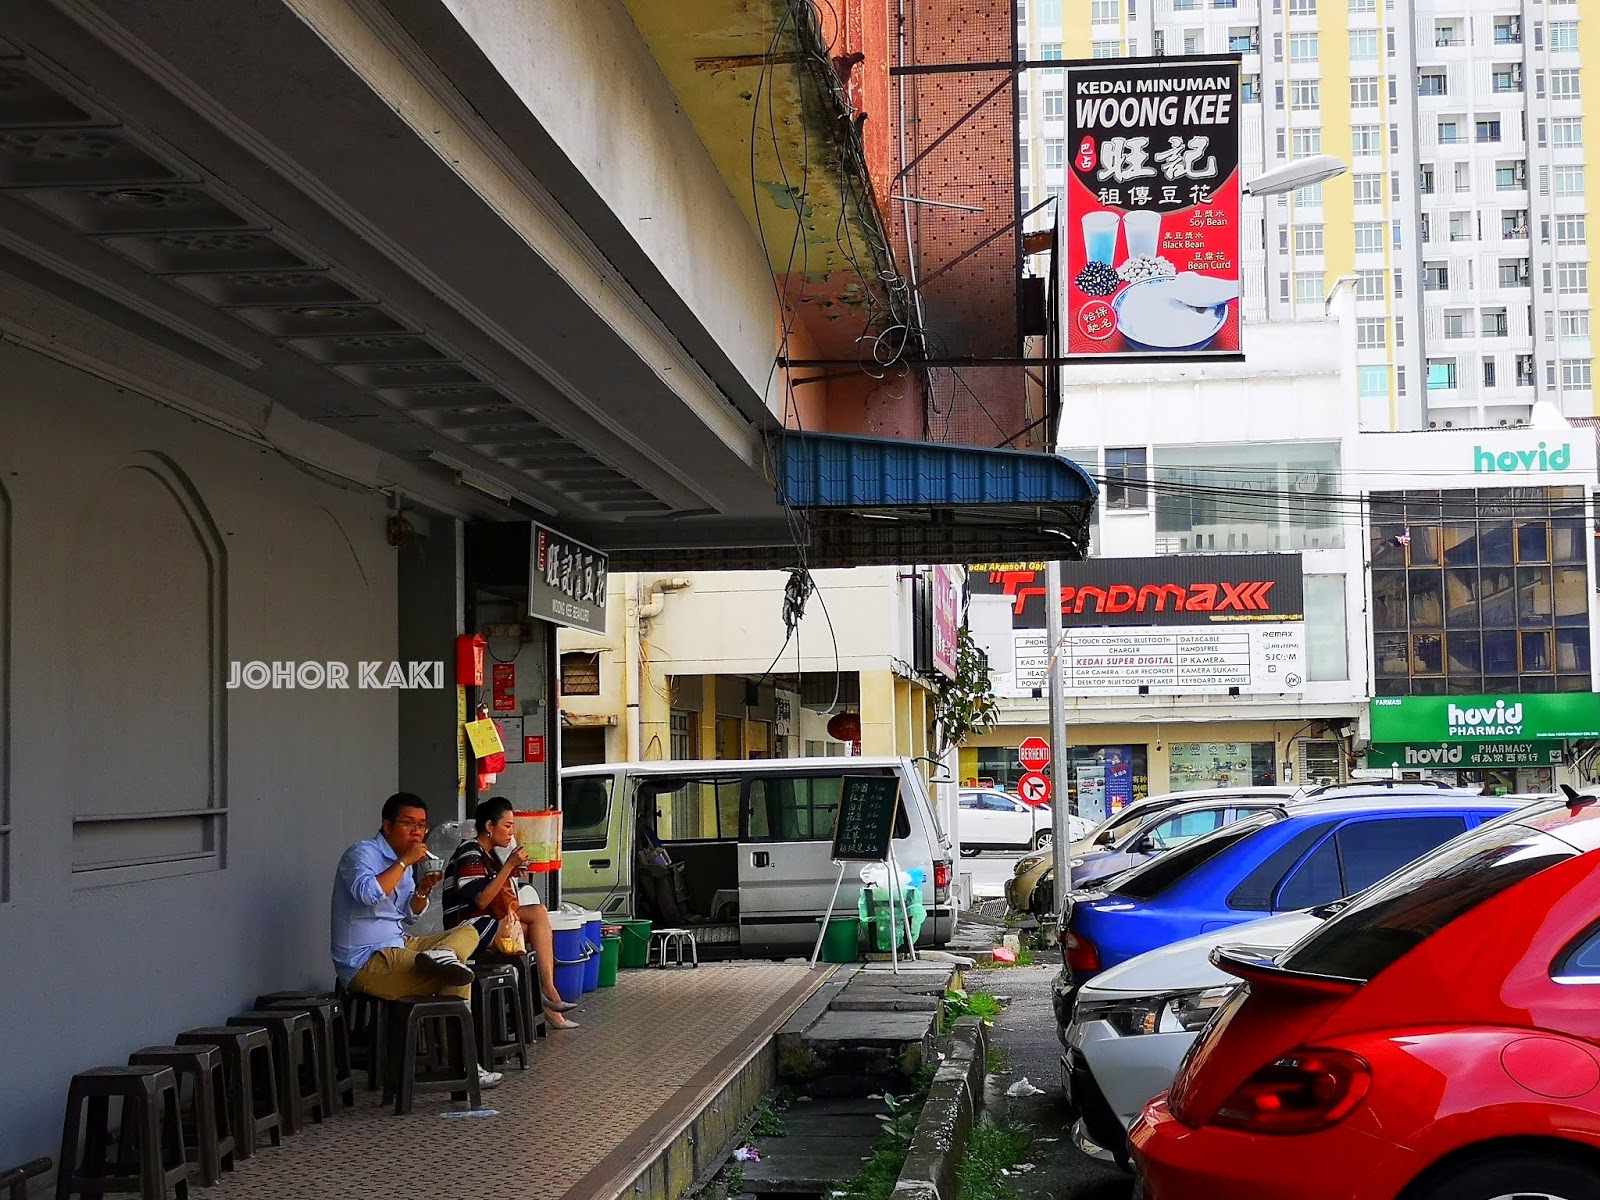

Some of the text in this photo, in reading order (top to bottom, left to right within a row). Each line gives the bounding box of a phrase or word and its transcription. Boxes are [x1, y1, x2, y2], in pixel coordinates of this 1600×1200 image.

[1077, 77, 1230, 94] KEDAI MINUMAN
[1076, 94, 1232, 128] WOONG KEE
[1097, 136, 1218, 183] 旺記
[1098, 184, 1213, 205] 祖傳豆花
[1189, 218, 1227, 228] Soy Bean
[1162, 241, 1183, 249] Black
[1188, 260, 1231, 270] Bean Curd
[1474, 441, 1571, 473] hovid
[1076, 656, 1174, 666] KEDAI SUPER DIGITAL
[1448, 700, 1523, 726] hovid
[1449, 726, 1523, 736] PHARMACY
[1021, 748, 1049, 760] BERHENTI
[1405, 743, 1463, 764] hovid
[1478, 744, 1532, 753] PHARMACY
